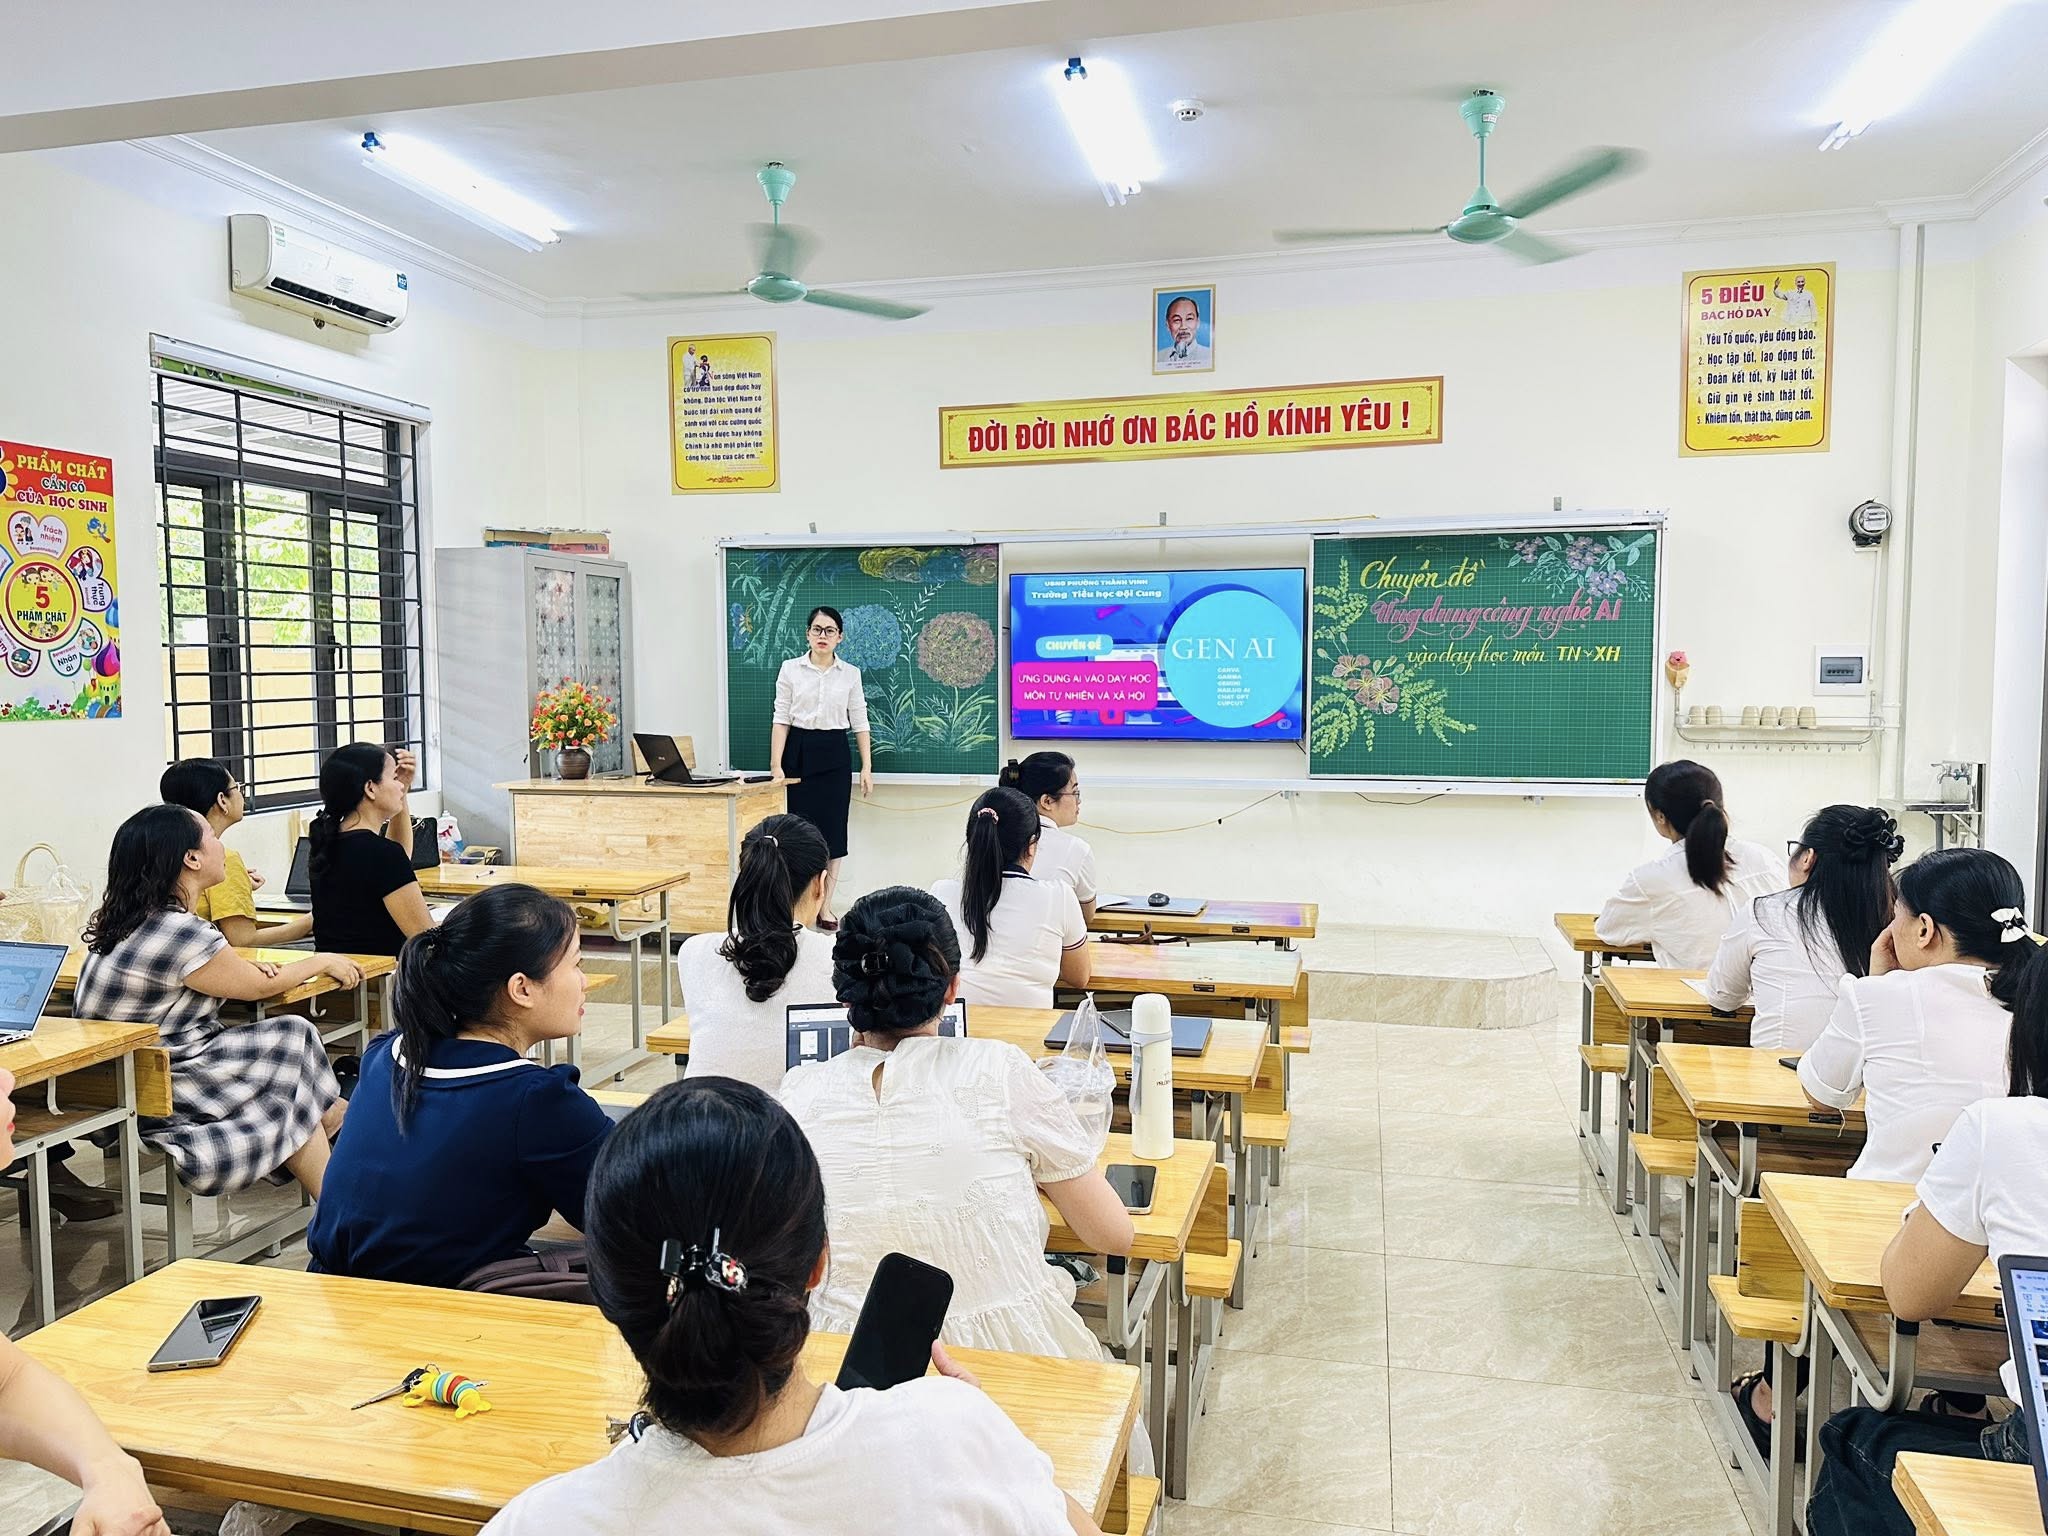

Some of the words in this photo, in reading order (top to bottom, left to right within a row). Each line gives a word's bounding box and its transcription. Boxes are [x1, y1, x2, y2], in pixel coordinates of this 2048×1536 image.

[1702, 289, 1712, 304] 5
[1719, 280, 1764, 303] ĐIỀU
[1707, 333, 1721, 345] Yêu
[1735, 330, 1757, 345] quốc,
[1759, 330, 1773, 343] yêu
[1698, 357, 1704, 365] 2.
[1707, 353, 1723, 367] Học
[1726, 351, 1739, 366] tập
[1761, 350, 1774, 362] lao
[1777, 349, 1798, 363] động
[1802, 346, 1815, 360] tốt.
[737, 372, 747, 380] Việt
[1698, 376, 1704, 385] 3.
[1732, 369, 1745, 383] kết
[1781, 369, 1797, 383] luật
[1801, 366, 1815, 380] tốt.
[1743, 390, 1753, 405] vệ
[1757, 390, 1775, 402] sinh
[1779, 388, 1796, 404] thật
[1801, 386, 1814, 400] tốt.
[969, 419, 1008, 452] ĐỜI
[1015, 417, 1055, 450] ĐỜI
[1064, 414, 1115, 448] NHỚ
[1123, 415, 1157, 445] ƠN
[1166, 409, 1216, 442] BÁC
[1225, 401, 1259, 439] HỒ
[1268, 403, 1331, 436] KÍNH
[1341, 398, 1391, 432] YÊU
[1402, 401, 1409, 429] !
[1697, 416, 1703, 425] 5.
[1705, 411, 1728, 424] Khiêm
[1744, 410, 1759, 425] thật
[17, 451, 62, 474] PHẨM
[67, 460, 107, 479] CHẤT
[71, 481, 84, 493] CÓ
[17, 488, 45, 505] CỦA
[49, 496, 75, 510] HỌC
[79, 500, 107, 512] SINH
[41, 533, 62, 544] nhiệm
[44, 525, 62, 535] Trách
[1360, 556, 1447, 599] Chuyên
[1447, 556, 1486, 588] đề
[36, 586, 50, 608] 5
[97, 583, 106, 607] Trung
[1032, 590, 1068, 599] Trường
[1072, 589, 1094, 598] Tiểu
[1096, 590, 1115, 599] học
[1116, 589, 1134, 599] Đội
[1136, 590, 1162, 599] Cung
[1423, 595, 1485, 640] dụng
[1483, 597, 1533, 640] công
[1537, 586, 1593, 640] nghệ
[1594, 599, 1622, 620] AI
[1045, 639, 1086, 651] CHUYÊN
[1171, 638, 1237, 660] GEN
[1243, 637, 1277, 660] AI
[1407, 645, 1438, 663] vào
[1440, 642, 1475, 675] dạy
[1477, 635, 1509, 666] học
[1557, 646, 1581, 661] TN
[1593, 646, 1621, 661] XH
[1043, 674, 1071, 684] DỤNG
[1073, 674, 1082, 684] AI
[1024, 690, 1046, 700] MÔN
[1065, 690, 1095, 701] NHIÊN
